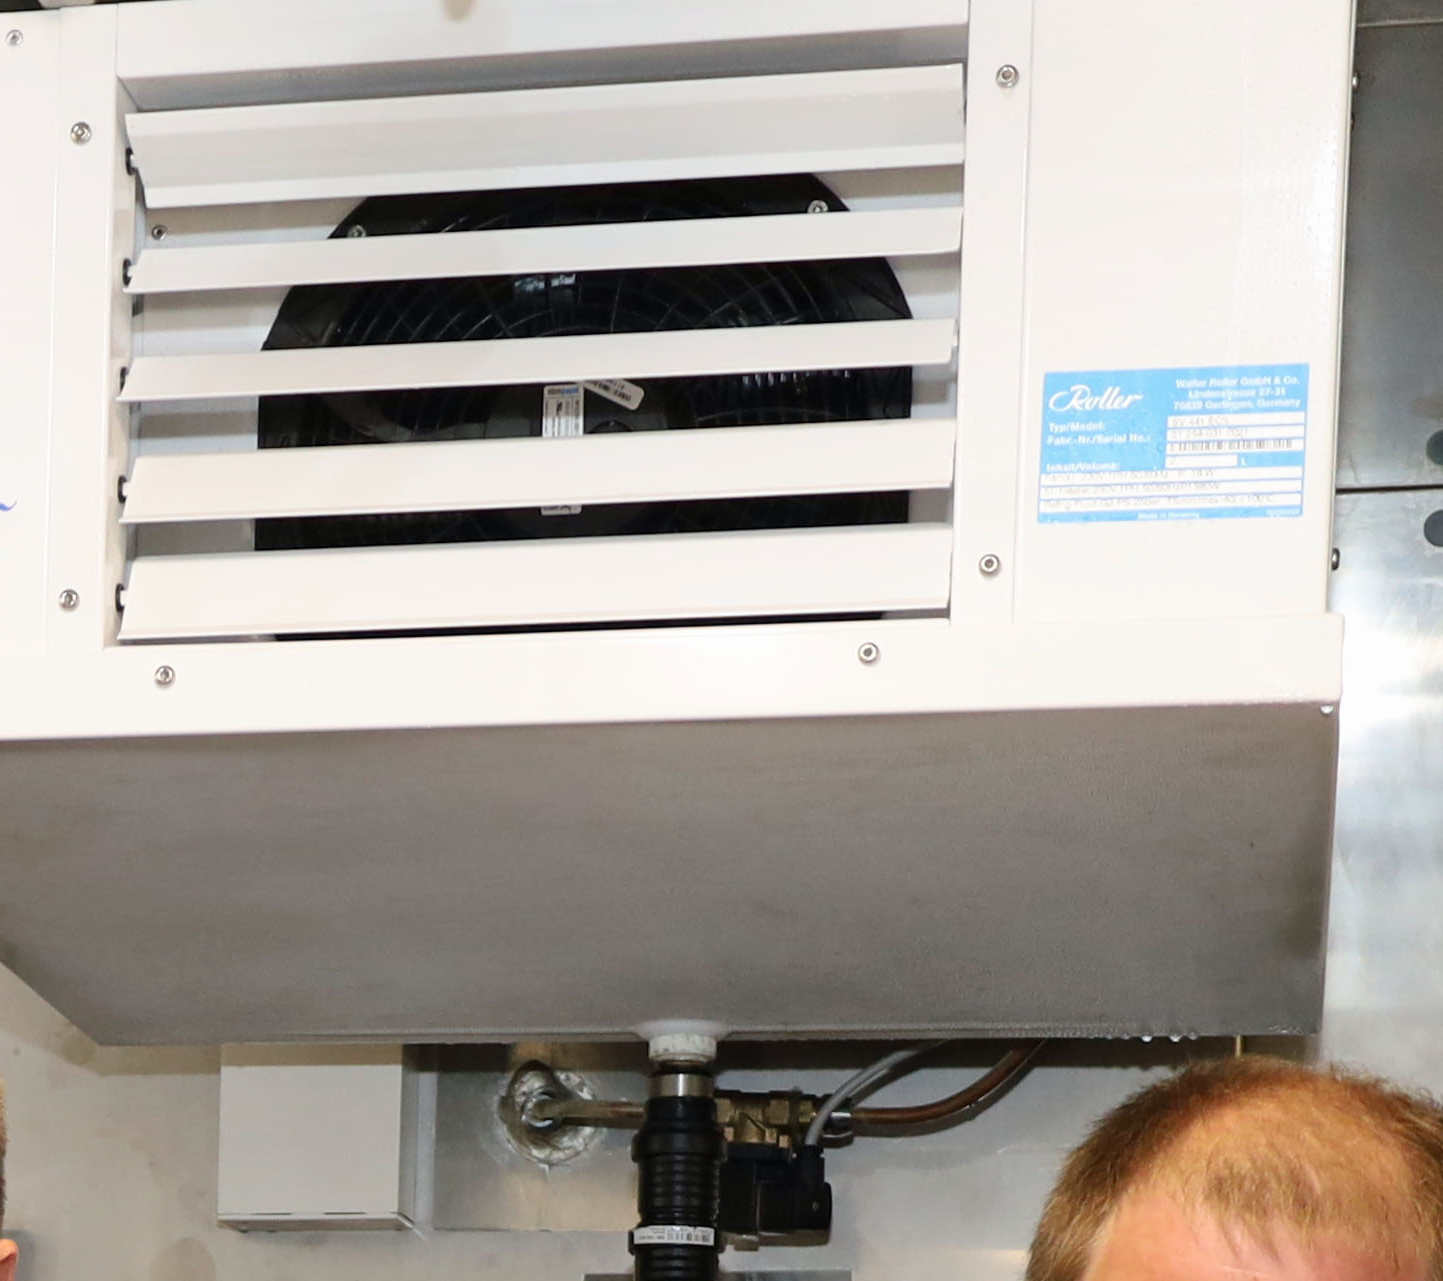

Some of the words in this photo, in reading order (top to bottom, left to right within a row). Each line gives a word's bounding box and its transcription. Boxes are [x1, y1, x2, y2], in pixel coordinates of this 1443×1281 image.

[1240, 376, 1271, 386] GmbH
[1273, 376, 1281, 385] &
[1283, 375, 1300, 385] Co.
[1049, 384, 1144, 412] Roller
[1257, 398, 1301, 408] Germany
